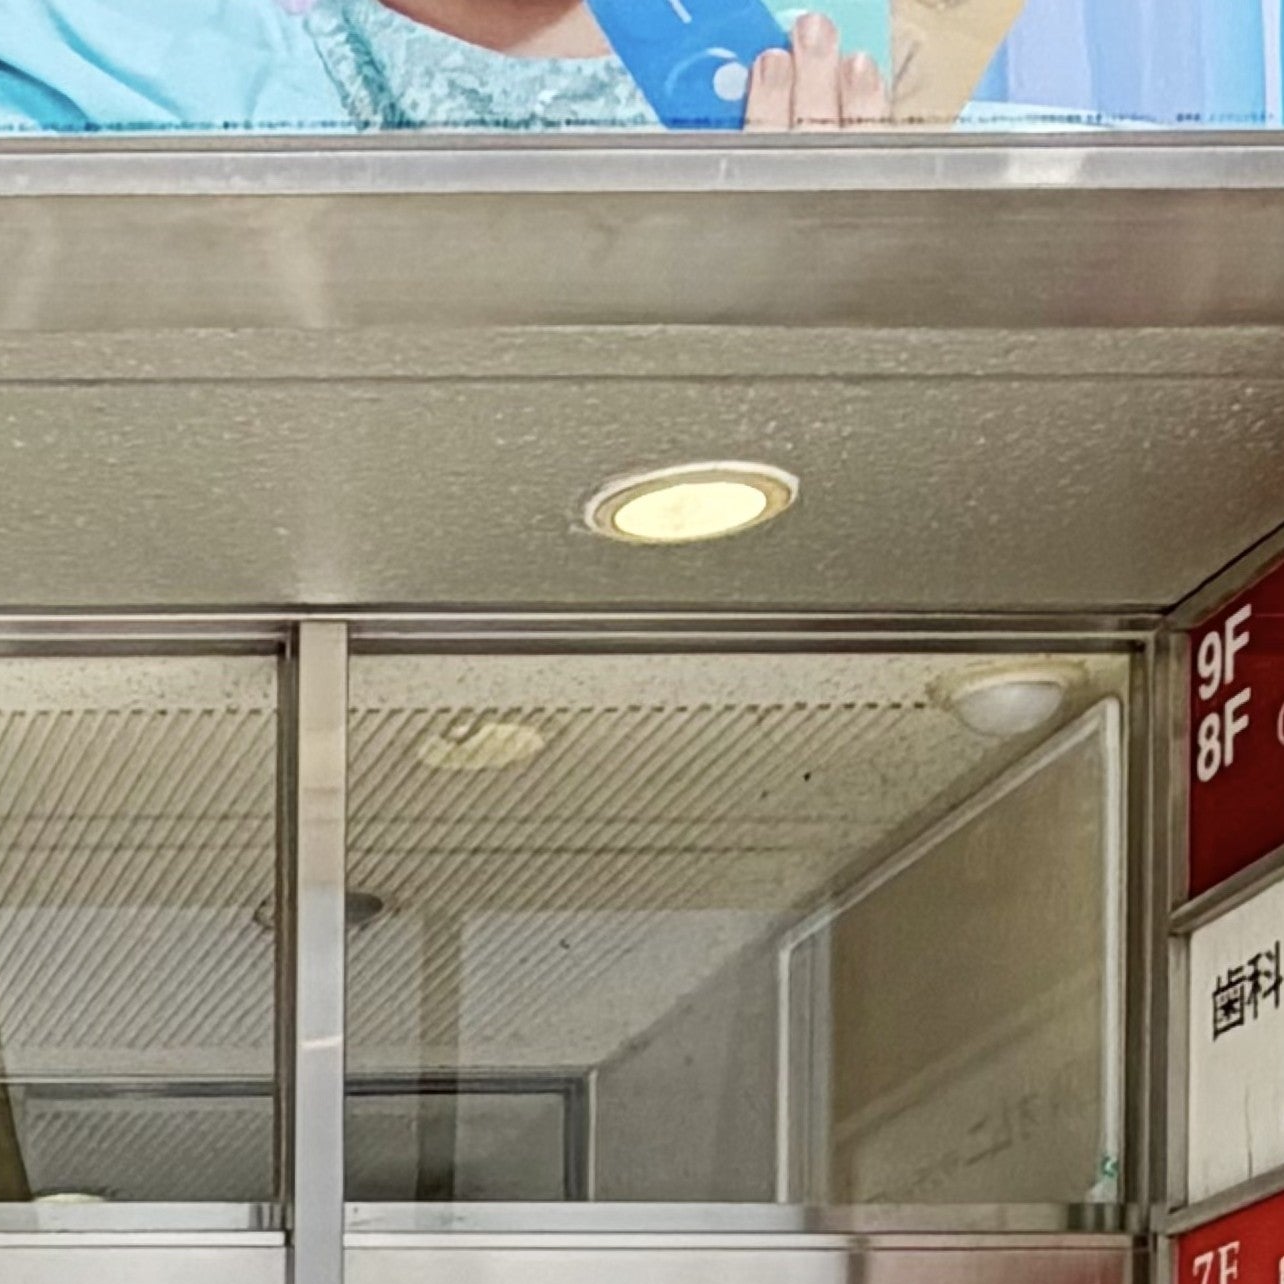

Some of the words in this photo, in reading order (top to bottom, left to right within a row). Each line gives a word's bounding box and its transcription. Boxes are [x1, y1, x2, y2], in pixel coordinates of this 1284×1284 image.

[1197, 603, 1252, 701] 9F
[1196, 686, 1252, 783] 8F
[1212, 940, 1284, 1041] 歯科
